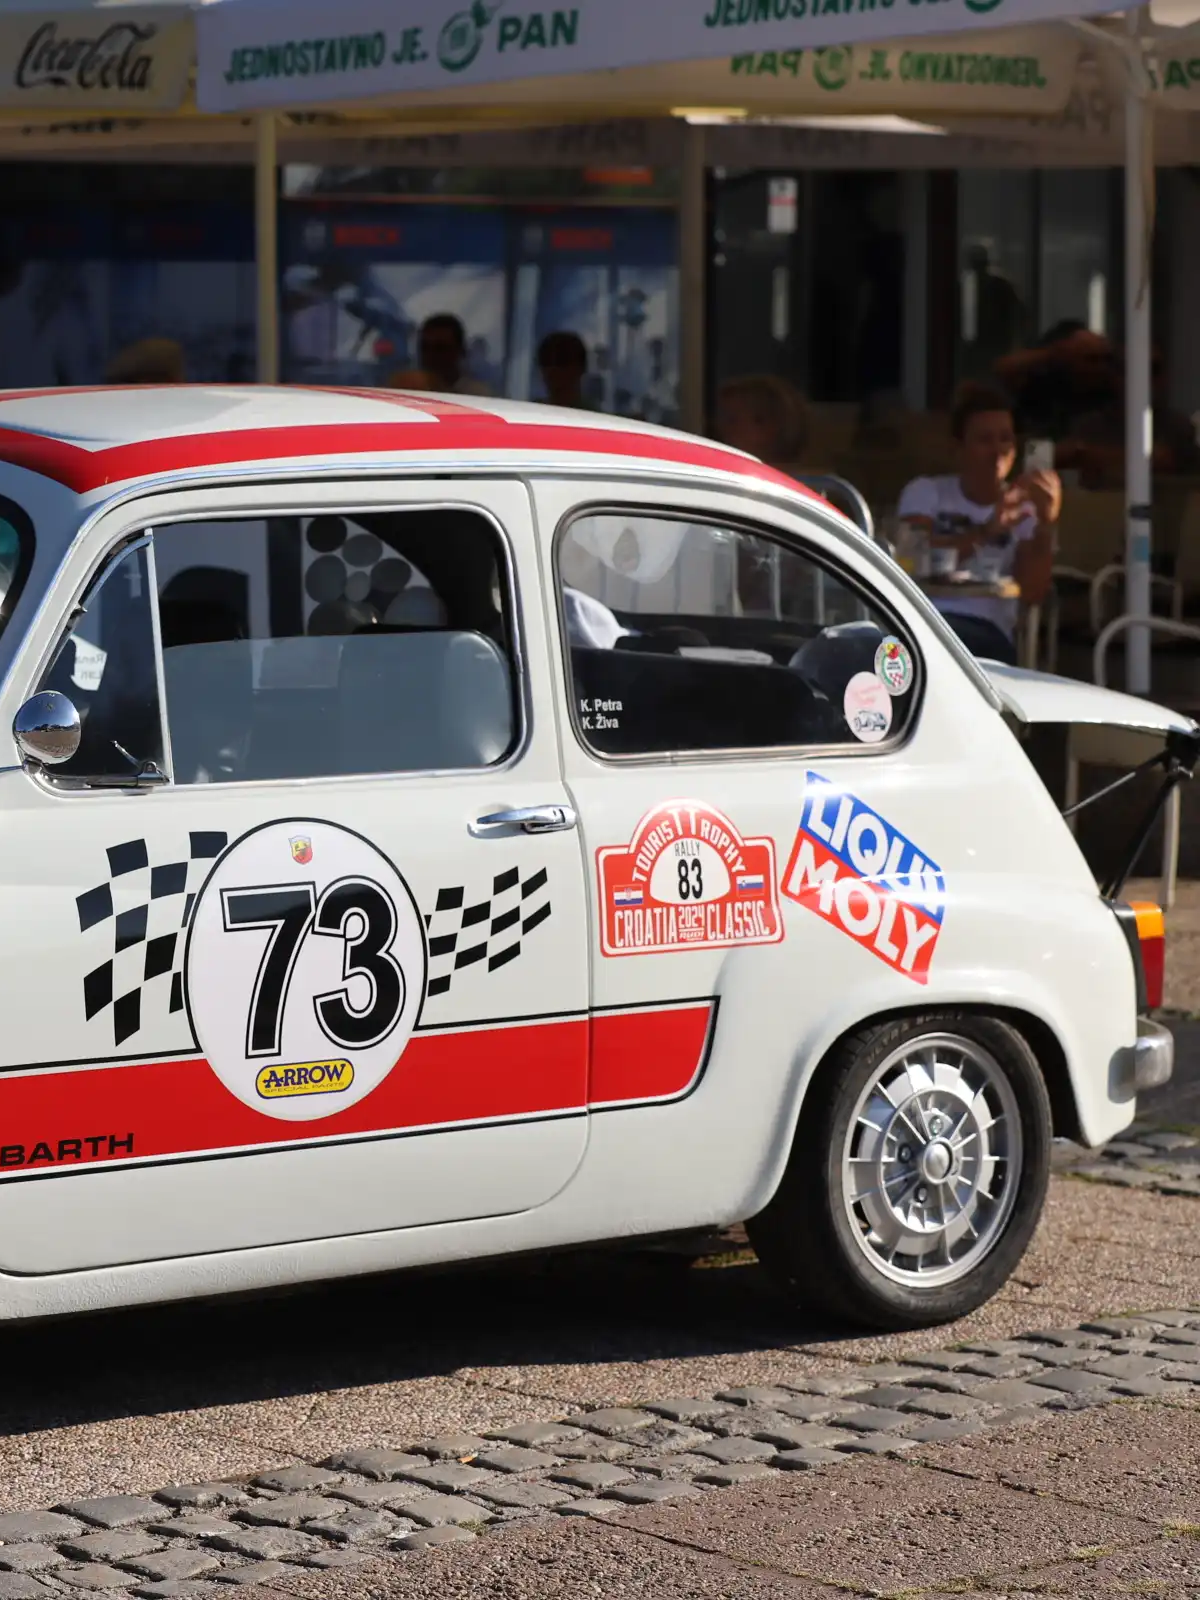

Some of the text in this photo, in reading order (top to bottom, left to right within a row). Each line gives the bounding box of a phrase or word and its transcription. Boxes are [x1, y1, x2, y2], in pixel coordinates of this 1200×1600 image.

[14, 22, 160, 91] Coca-Cola
[224, 10, 579, 84] JEDNOSTAVNO JE. PAN
[580, 698, 623, 712] K. Petra
[582, 713, 619, 730] K. Živa
[632, 807, 747, 883] TOURIST TROPHY
[675, 840, 700, 857] RALLY
[807, 779, 943, 915] LIQUI
[677, 858, 703, 900] 83
[614, 900, 770, 948] CROATIA CLASSIC
[678, 905, 705, 928] 2024
[788, 838, 938, 972] MOLY
[219, 874, 406, 1059] 73
[262, 1063, 346, 1089] ARROW
[264, 1086, 310, 1094] SPECIAL
